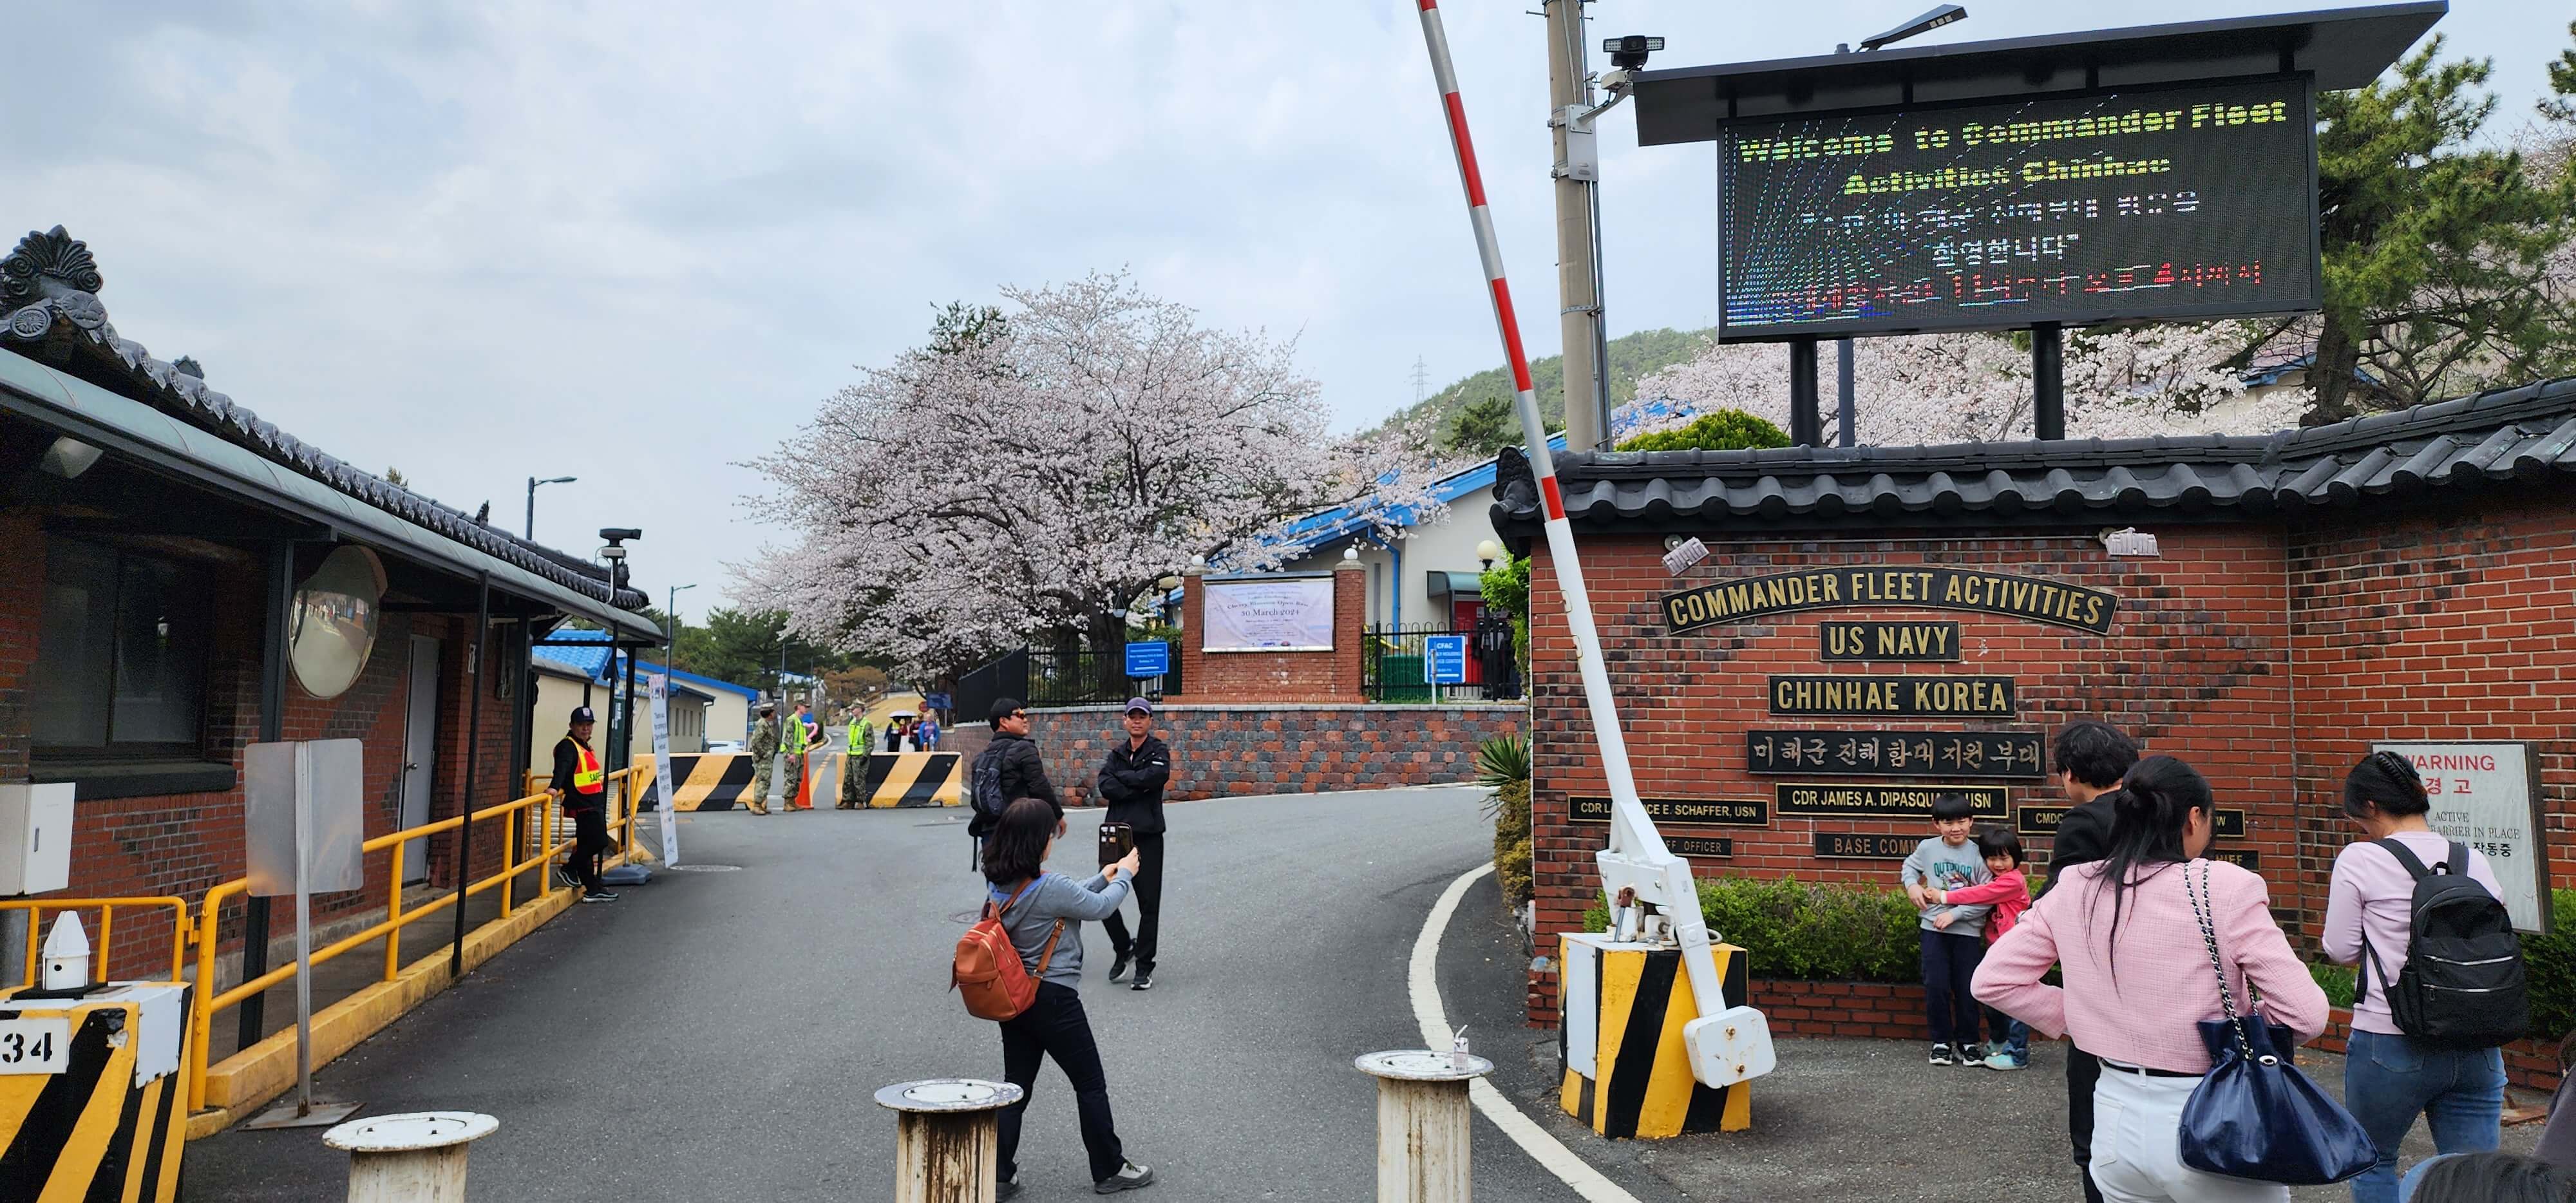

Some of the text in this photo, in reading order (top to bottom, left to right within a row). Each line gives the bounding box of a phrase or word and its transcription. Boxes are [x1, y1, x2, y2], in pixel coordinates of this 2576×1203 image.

[1739, 101, 2286, 162] Welcome to Commander Fleet
[1844, 165, 2010, 194] Activities
[1670, 571, 2103, 627] COMMANDER FLEET ACTIVITIES
[1253, 608, 1278, 616] March
[1828, 626, 1949, 656] US NAVY
[1778, 680, 2008, 711] CHINHAE KOREA
[1792, 791, 1817, 806] CDR
[1821, 790, 1862, 806] JAMES
[1865, 791, 1877, 807] A.
[1880, 791, 1941, 808] DIPASQU
[1580, 802, 1602, 813] CDR
[1663, 804, 1672, 815] E.
[1675, 805, 1732, 818] SCHAFFER,
[1735, 807, 1757, 817] USN
[2036, 813, 2063, 824] CMDC
[2436, 811, 2469, 822] ACTIVE
[2474, 827, 2485, 837] IN
[2488, 828, 2520, 839] PLACE
[1684, 842, 1721, 853] OFFICER
[1834, 838, 1871, 854] BASE
[2215, 855, 2242, 865] HIEF
[2, 1032, 53, 1063] 34
